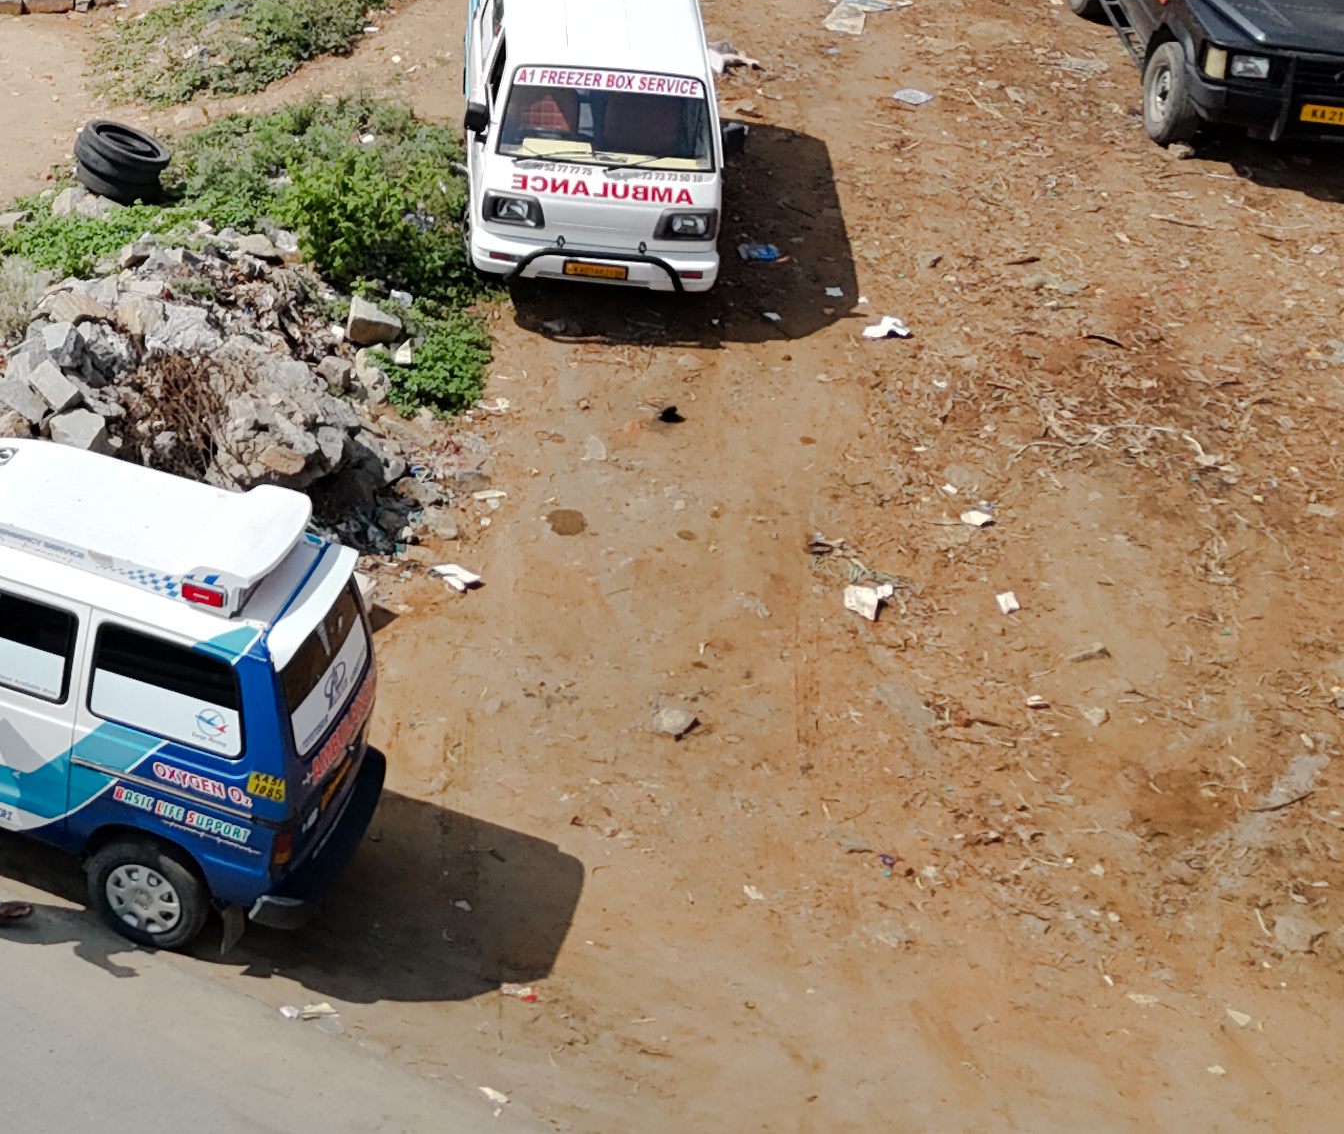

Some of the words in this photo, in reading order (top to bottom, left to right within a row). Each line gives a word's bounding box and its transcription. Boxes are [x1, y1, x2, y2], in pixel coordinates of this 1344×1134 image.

[517, 68, 536, 84] A1
[539, 69, 602, 89] FREEZER
[605, 72, 635, 90] BOX
[637, 74, 698, 97] SERVICE
[153, 761, 226, 800] OXYGEN
[114, 785, 154, 812] BASIC
[155, 799, 185, 821] LIFE
[187, 809, 251, 844] SUPPORT
